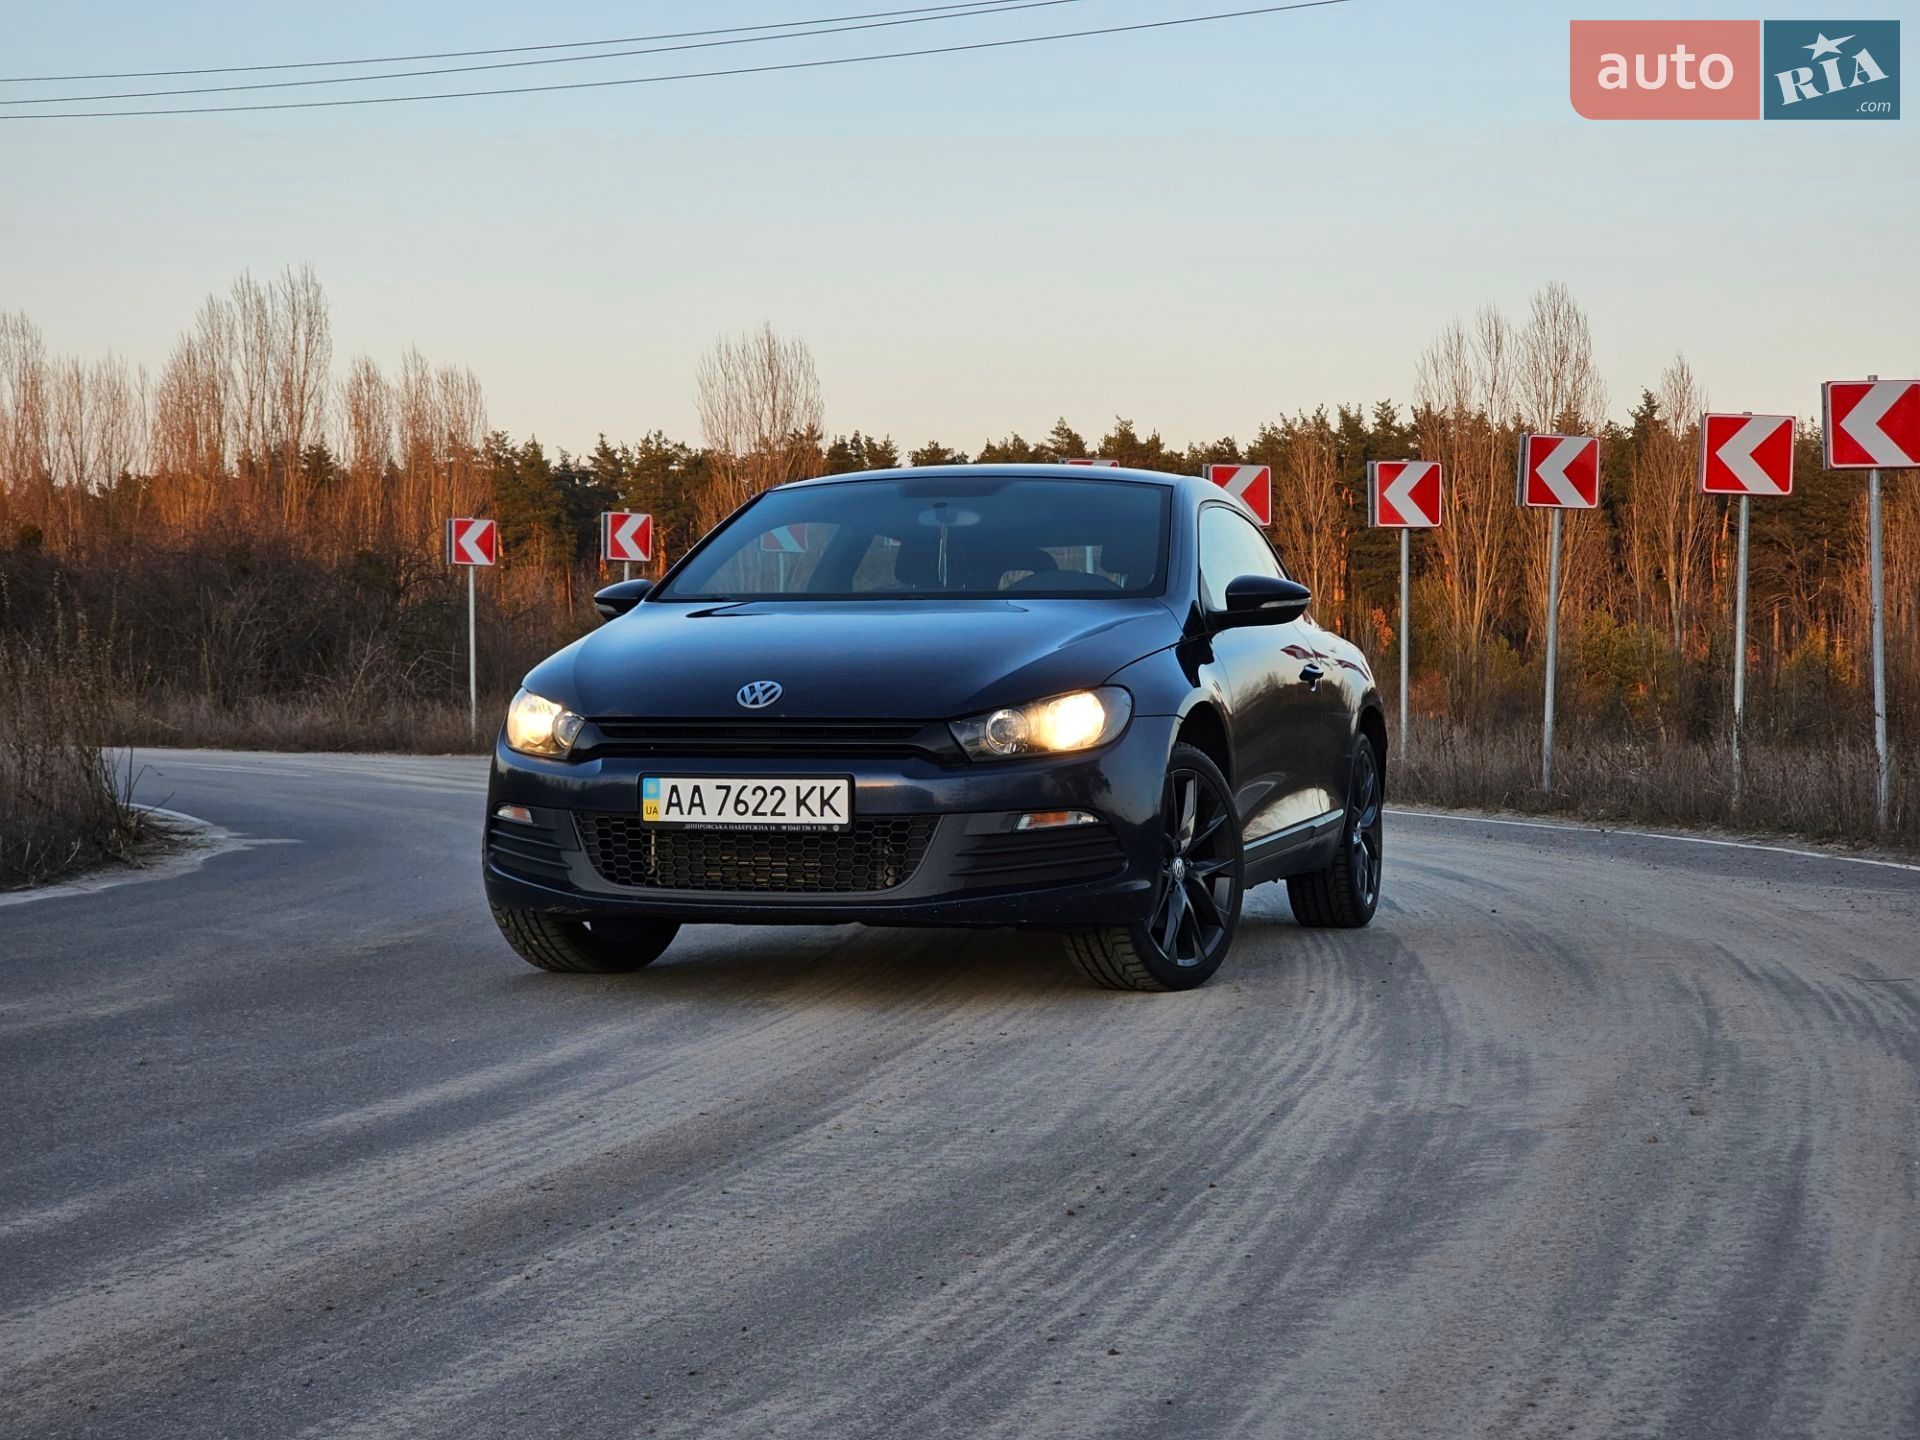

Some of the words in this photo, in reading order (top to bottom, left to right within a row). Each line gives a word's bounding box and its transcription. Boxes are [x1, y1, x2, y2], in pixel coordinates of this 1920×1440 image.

[645, 806, 659, 816] UA
[665, 784, 707, 816] AA
[715, 784, 786, 816] 7622
[795, 785, 842, 817] KK
